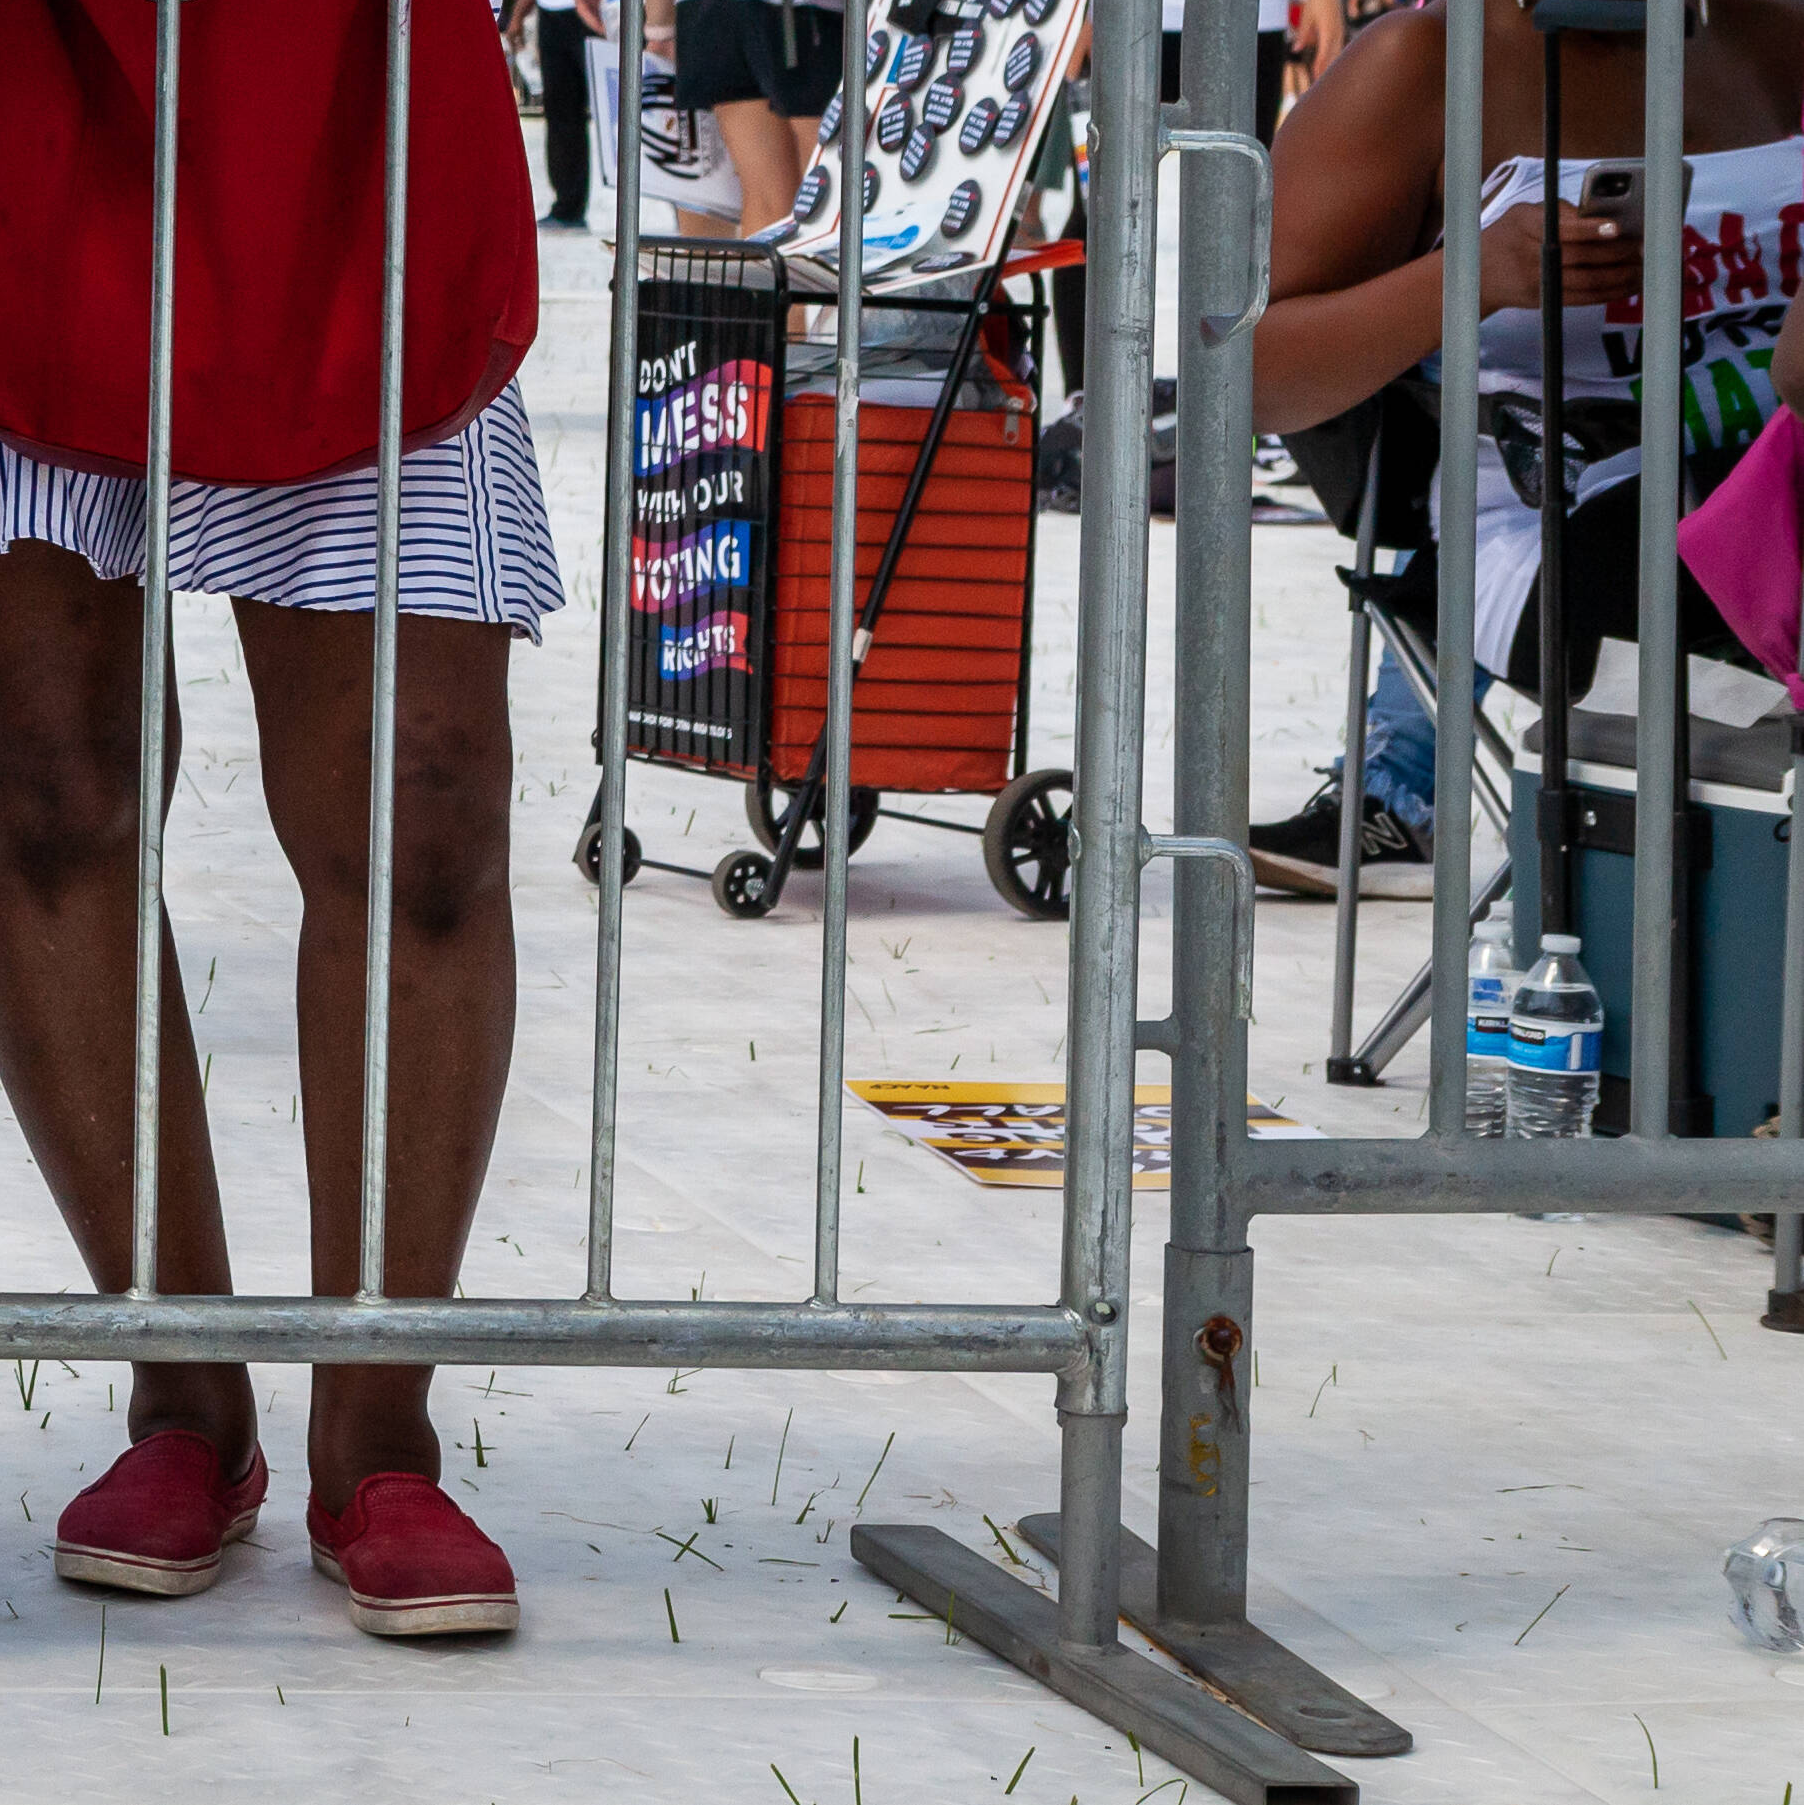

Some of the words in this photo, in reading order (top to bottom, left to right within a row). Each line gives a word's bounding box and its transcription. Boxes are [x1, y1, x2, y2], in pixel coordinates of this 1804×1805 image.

[639, 340, 697, 393] DON'T
[641, 380, 749, 470] MESS
[692, 469, 744, 512] OUR
[633, 534, 740, 601] VOTING
[663, 624, 736, 672] RIGHTS
